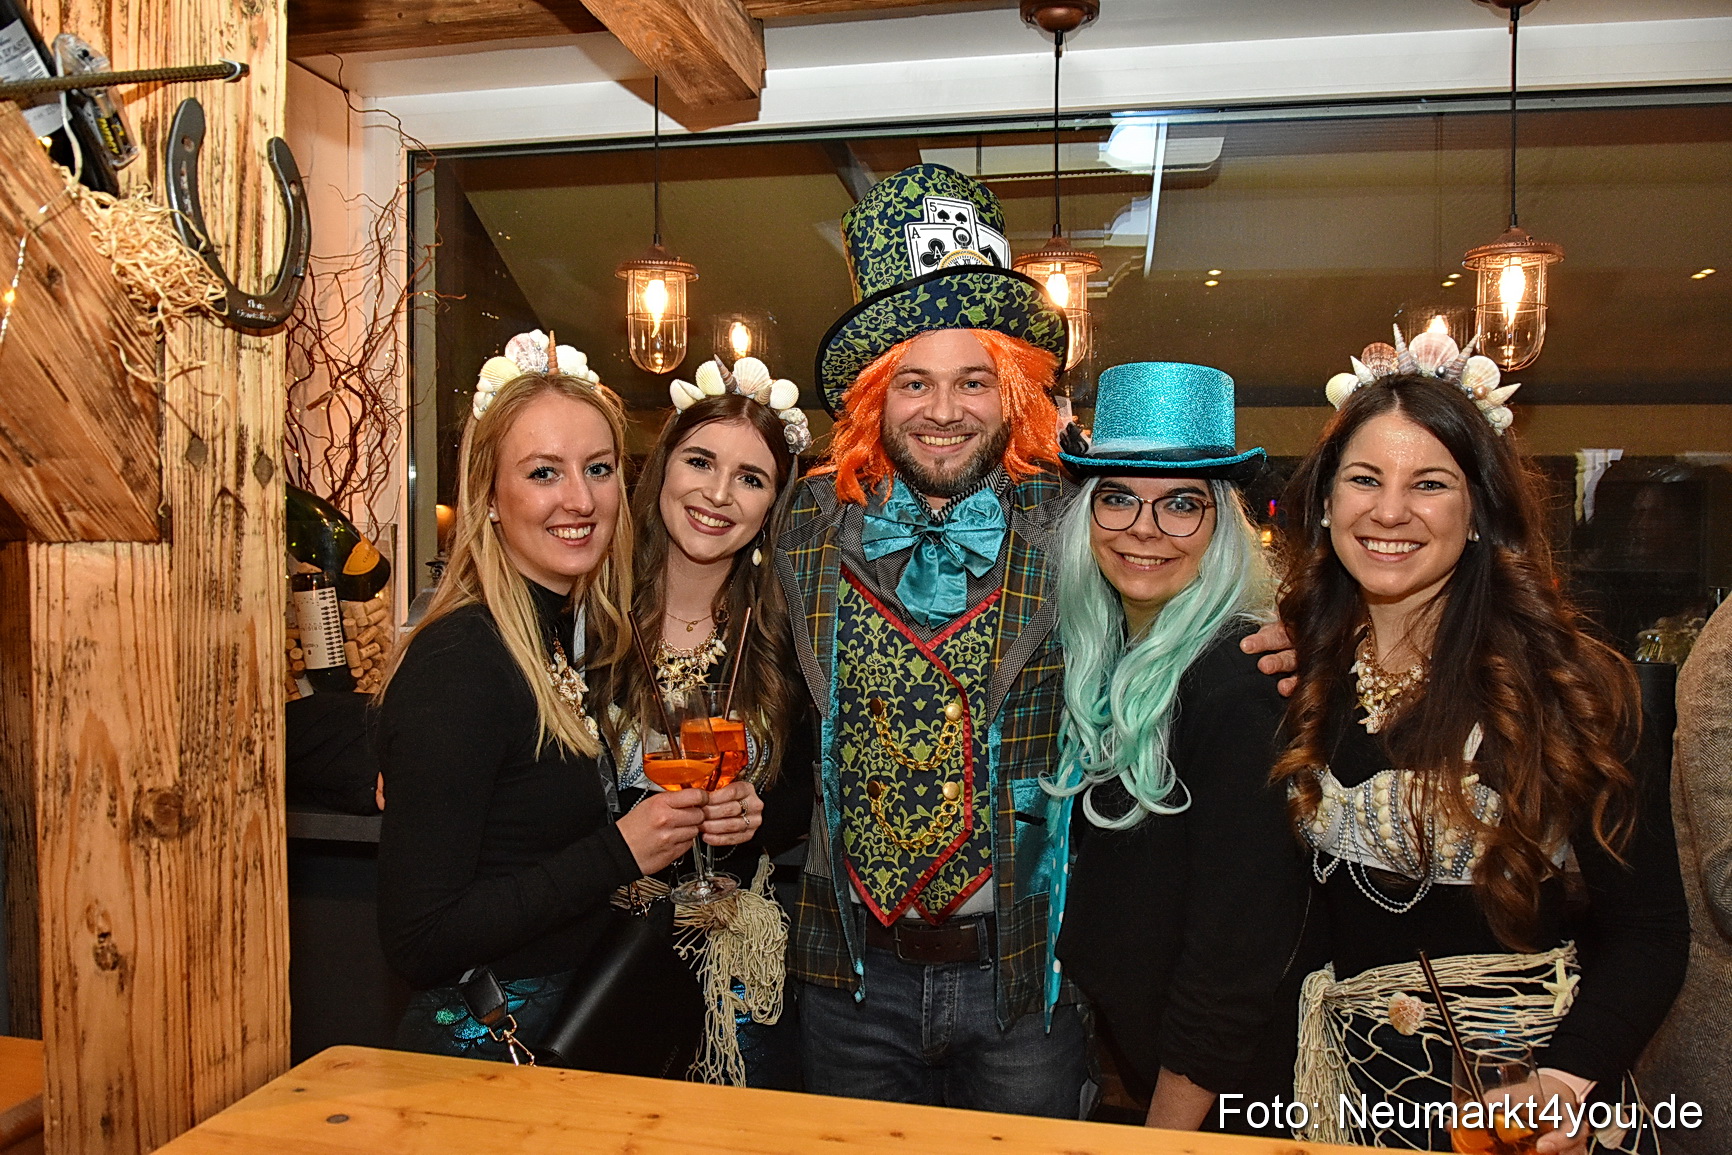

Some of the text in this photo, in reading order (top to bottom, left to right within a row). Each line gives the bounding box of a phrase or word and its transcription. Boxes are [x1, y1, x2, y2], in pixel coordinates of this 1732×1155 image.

[930, 202, 938, 212] 5
[912, 227, 921, 239] A
[934, 246, 944, 260] A
